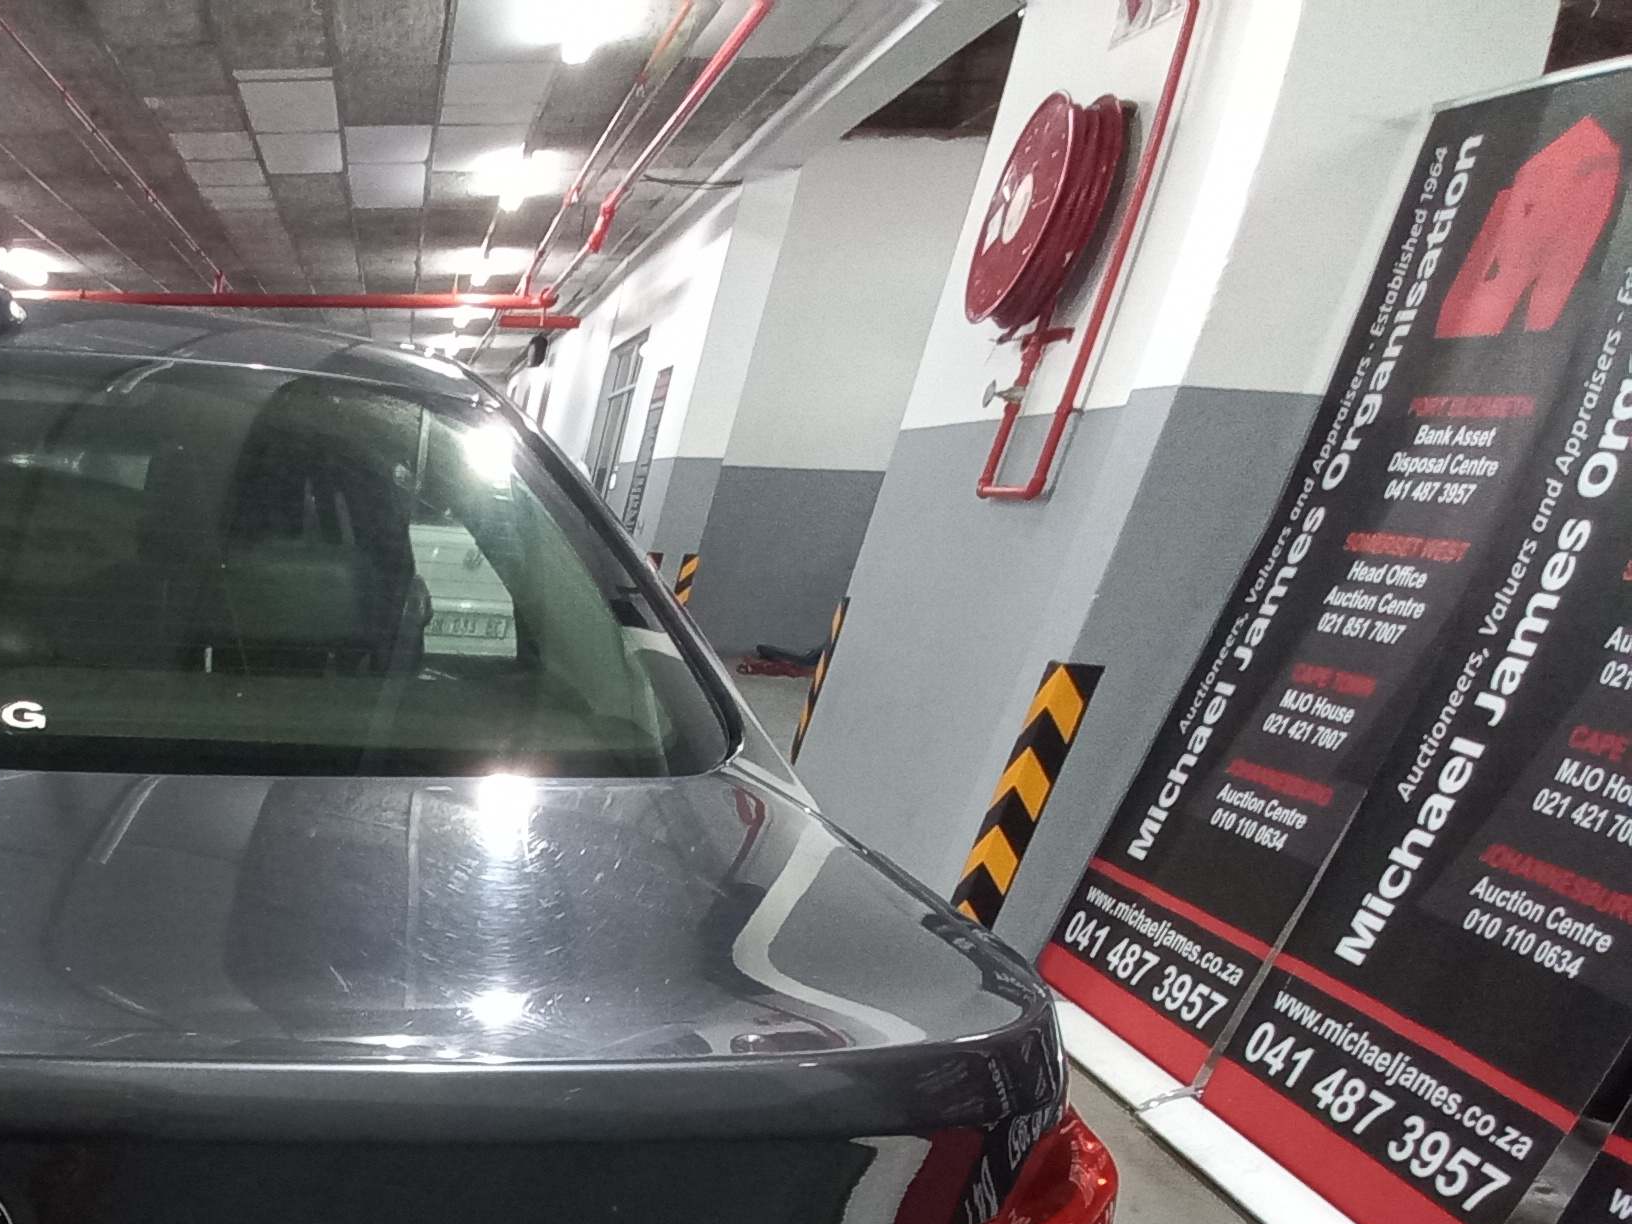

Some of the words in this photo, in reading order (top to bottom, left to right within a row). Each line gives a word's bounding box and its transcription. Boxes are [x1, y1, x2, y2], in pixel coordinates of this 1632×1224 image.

[1179, 612, 1250, 735] Auctioneers,
[1245, 526, 1292, 603] Valuers
[1290, 478, 1315, 520] and
[1313, 356, 1371, 474] Appraisers
[1370, 208, 1428, 337] Established
[1420, 146, 1448, 204] 1964
[1413, 424, 1454, 446] Bank
[1451, 425, 1497, 448] Asset
[1387, 451, 1451, 477] Disposal
[1449, 453, 1500, 477] Centre
[1127, 681, 1236, 861] Michael
[1234, 506, 1325, 671] James
[1322, 134, 1484, 490] Organisation
[1383, 478, 1413, 500] 041
[1412, 480, 1441, 502] 487
[1437, 483, 1478, 505] 3957
[1346, 559, 1389, 583] Head
[1385, 564, 1428, 589] Office
[1396, 647, 1489, 803] Auctioneers,
[1478, 537, 1538, 635] Valuers
[1531, 477, 1563, 533] and
[1555, 328, 1621, 475] Appraisers
[1323, 585, 1378, 611] Auction
[1377, 592, 1426, 619] Centre
[1317, 611, 1346, 634] 021
[1341, 616, 1372, 638] 851
[1367, 620, 1408, 645] 7007
[1279, 688, 1315, 713] MJO
[1310, 695, 1356, 725] House
[1262, 712, 1290, 735] 021
[1287, 719, 1315, 743] 421
[1310, 725, 1349, 751] 7007
[1334, 736, 1485, 966] Michael
[1474, 518, 1592, 726] James
[1554, 757, 1605, 792] MJO
[1216, 782, 1266, 815] Auction
[1264, 799, 1309, 830] Centre
[1532, 788, 1572, 820] 021
[1570, 801, 1610, 833] 421
[1210, 807, 1237, 830] 010
[1234, 816, 1260, 840] 110
[1254, 823, 1289, 852] 0634
[1085, 885, 1245, 987] www.michaeljames.co.za
[1469, 875, 1546, 924] Auction
[1545, 906, 1614, 954] Centre
[1463, 908, 1503, 939] 010
[1501, 924, 1537, 956] 110
[1533, 939, 1586, 979] 0634
[1064, 910, 1110, 959] 041
[1106, 937, 1161, 986] 487
[1152, 964, 1229, 1030] 3957
[1273, 989, 1534, 1161] www.michaeljames.co.za
[1244, 1021, 1315, 1088] 041
[1311, 1067, 1396, 1135] 487
[1387, 1115, 1512, 1212] 3957
